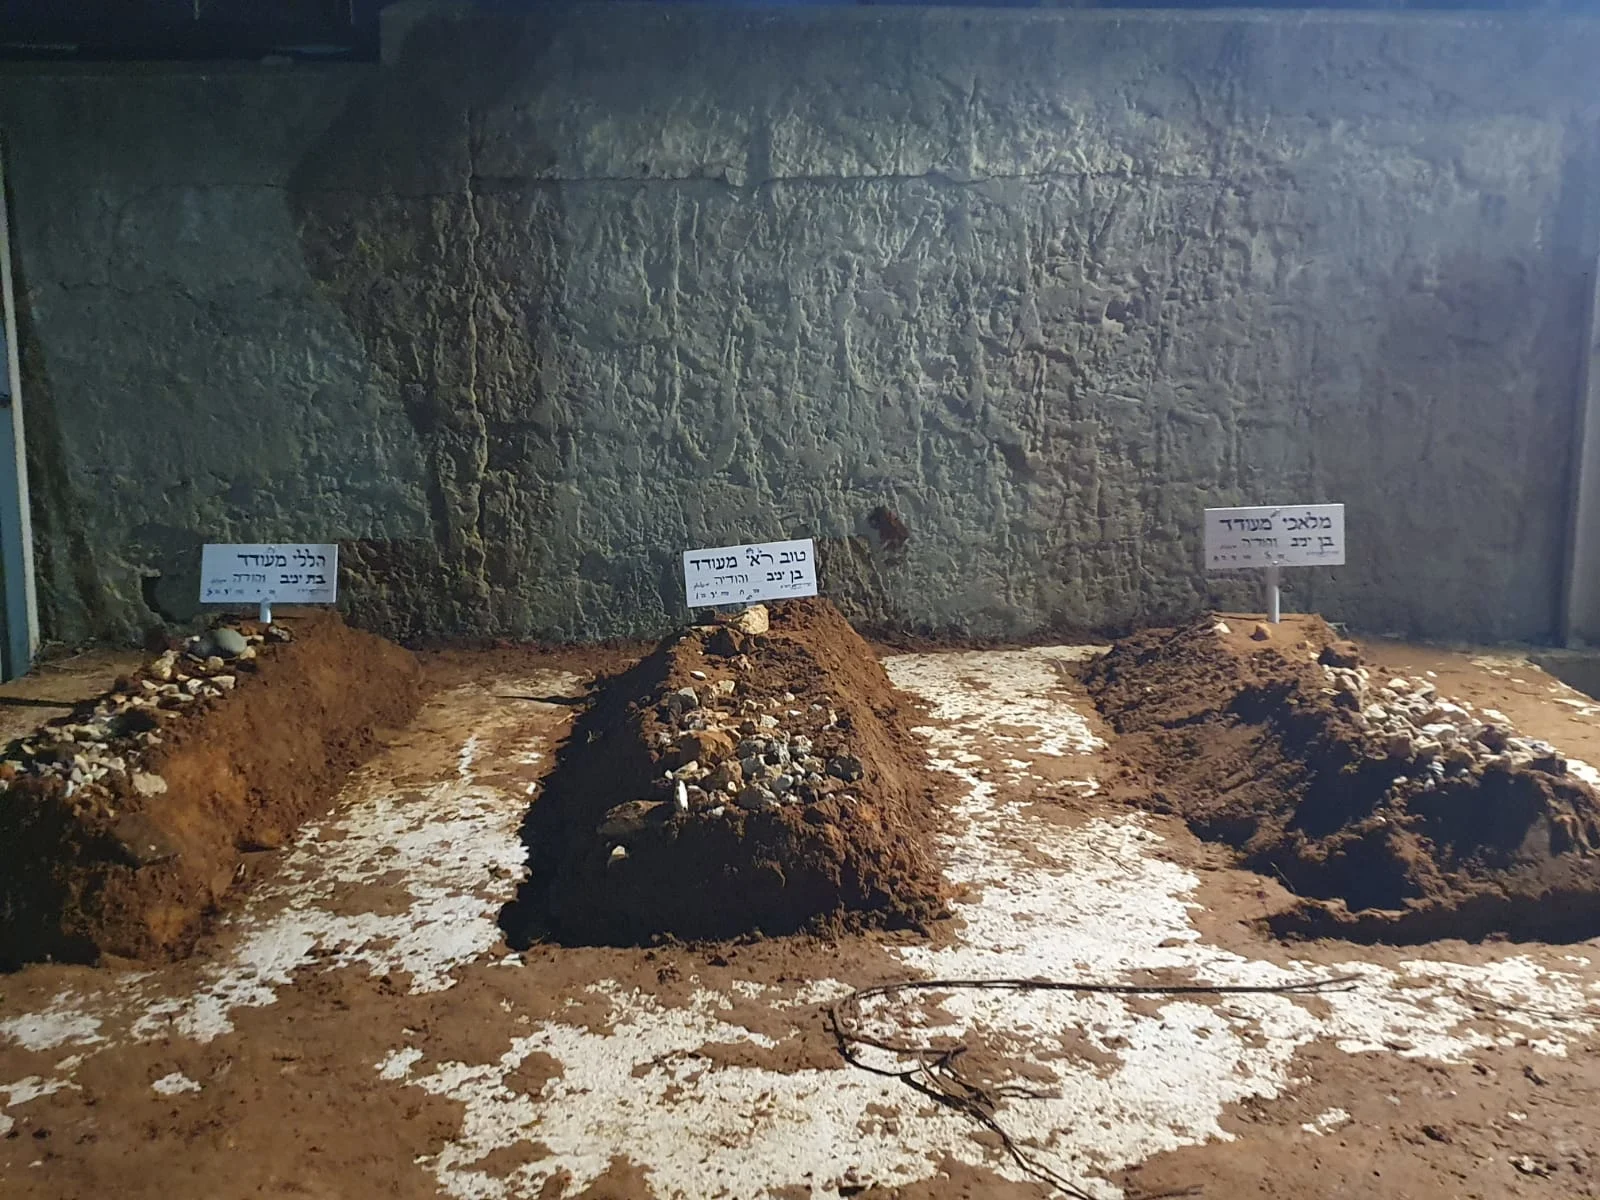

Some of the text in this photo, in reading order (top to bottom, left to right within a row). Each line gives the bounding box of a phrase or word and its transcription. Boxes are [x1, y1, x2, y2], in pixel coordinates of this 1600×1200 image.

[237, 548, 326, 567] הללי מעודד
[690, 556, 738, 571] מעודד
[779, 550, 806, 564] טוב
[279, 574, 303, 584] יניב
[305, 574, 326, 584] בת
[713, 574, 749, 586] והודיה
[766, 571, 785, 582] יניב
[790, 569, 804, 584] בן
